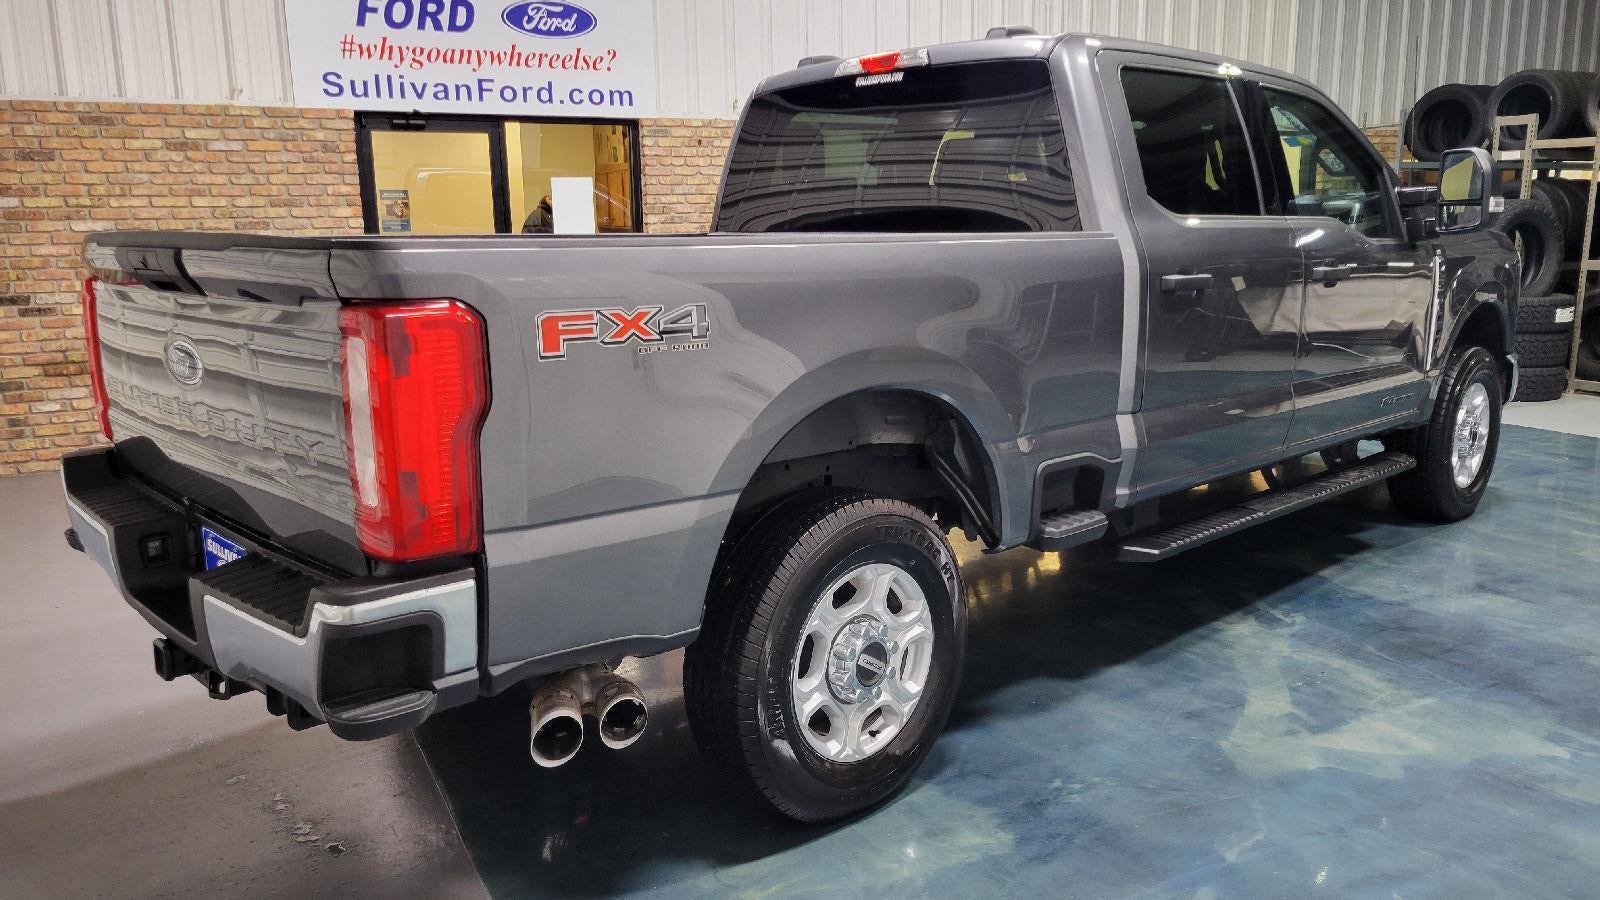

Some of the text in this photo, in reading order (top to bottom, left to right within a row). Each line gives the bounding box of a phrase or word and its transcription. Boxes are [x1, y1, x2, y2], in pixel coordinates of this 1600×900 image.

[356, 0, 475, 33] FORD
[522, 2, 578, 34] Ford
[339, 34, 617, 71] #whygoanywhereelse?
[321, 71, 634, 106] SullivanFord.com
[535, 302, 711, 362] FX4
[638, 345, 667, 354] OFF
[107, 376, 324, 466] SUPER DUTY
[207, 538, 242, 563] SULLIVA
